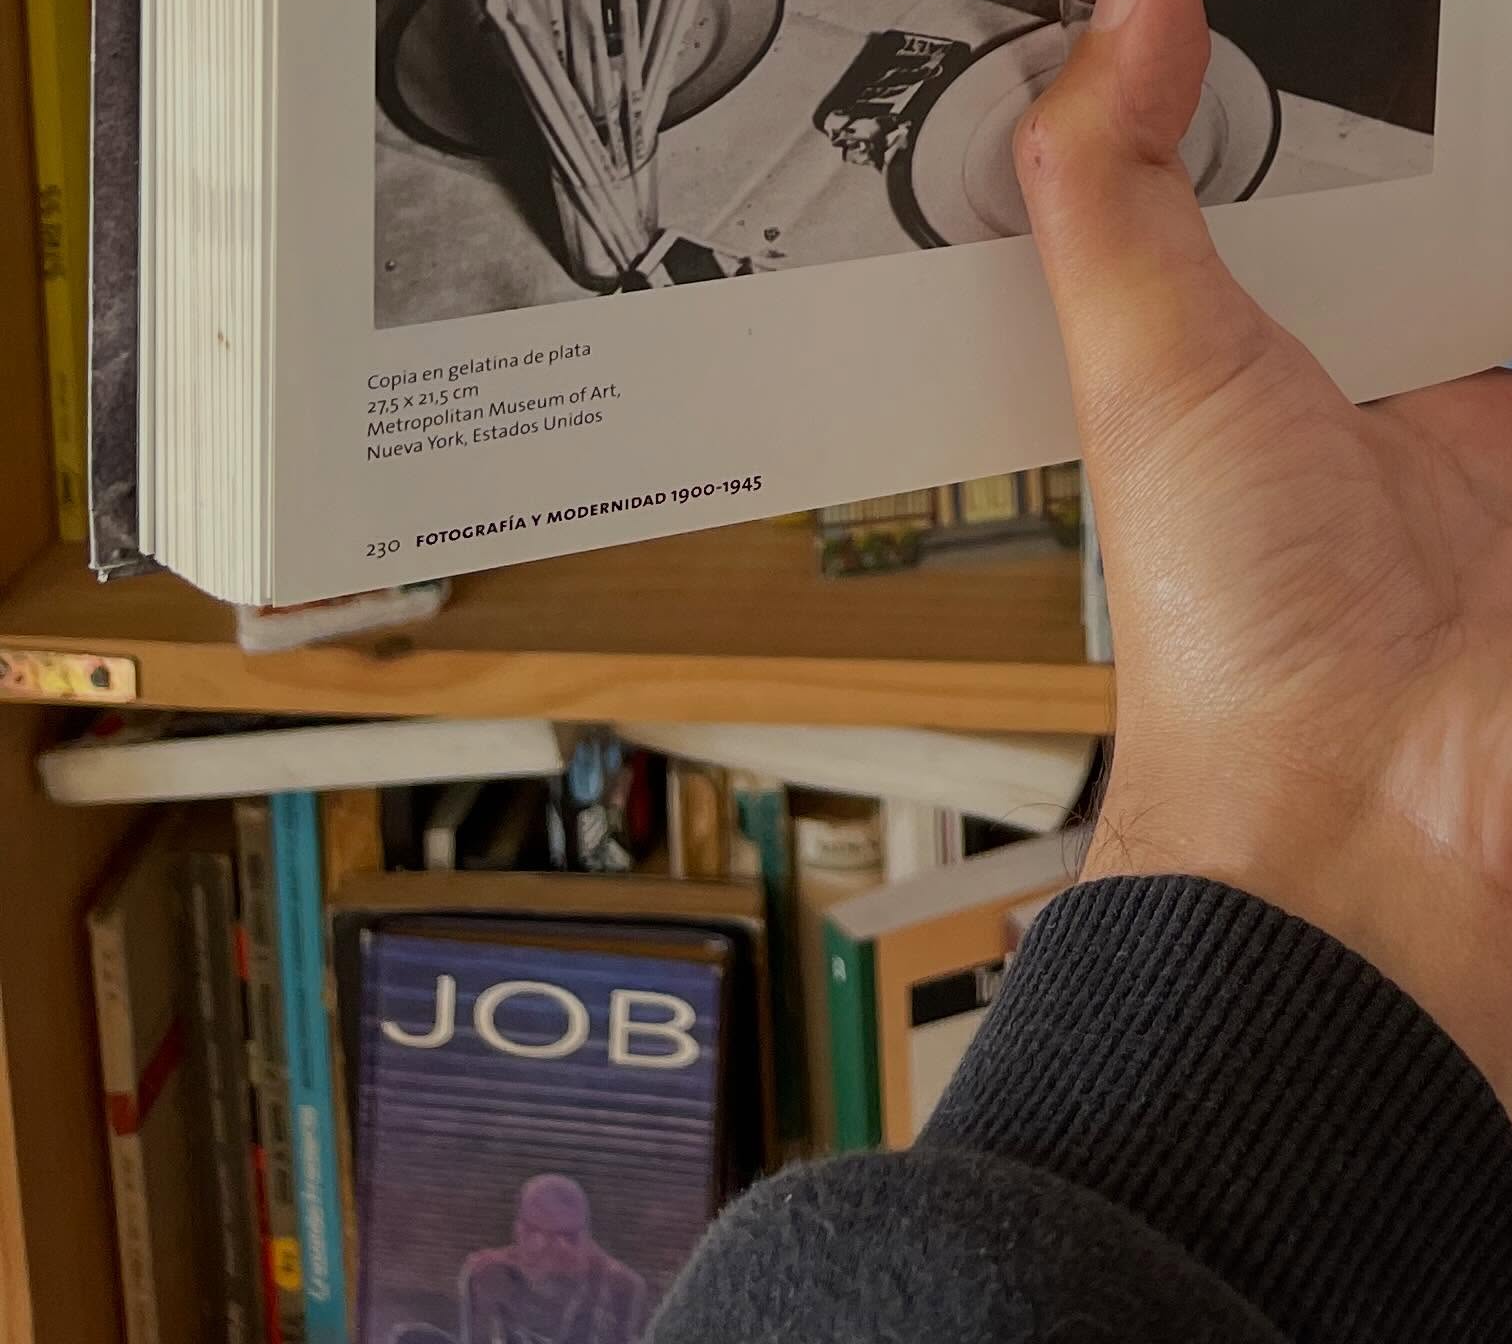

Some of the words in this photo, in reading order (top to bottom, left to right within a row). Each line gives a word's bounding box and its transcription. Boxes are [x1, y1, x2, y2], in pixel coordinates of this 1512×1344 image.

[367, 369, 418, 392] Copia
[421, 367, 444, 382] en
[447, 355, 519, 384] gelatina
[523, 349, 545, 366] de
[548, 343, 591, 366] plata
[366, 407, 484, 438] Metropolitan
[487, 394, 565, 417] Museum
[568, 386, 588, 405] of
[589, 383, 621, 401] Art,
[367, 397, 400, 416] 27,5
[402, 394, 414, 409] x
[417, 389, 449, 407] 21,5
[452, 385, 479, 401] cm
[367, 440, 423, 462] Nueva
[426, 430, 468, 451] York,
[472, 419, 539, 444] Estados
[543, 409, 603, 431] Unidos
[365, 539, 401, 560] 230
[415, 514, 527, 548] FOTOGRAFÍA
[530, 513, 543, 527] Y
[545, 492, 667, 525] MODERNIDAD
[670, 475, 763, 505] 1900-1945
[380, 974, 701, 1070] JOB
